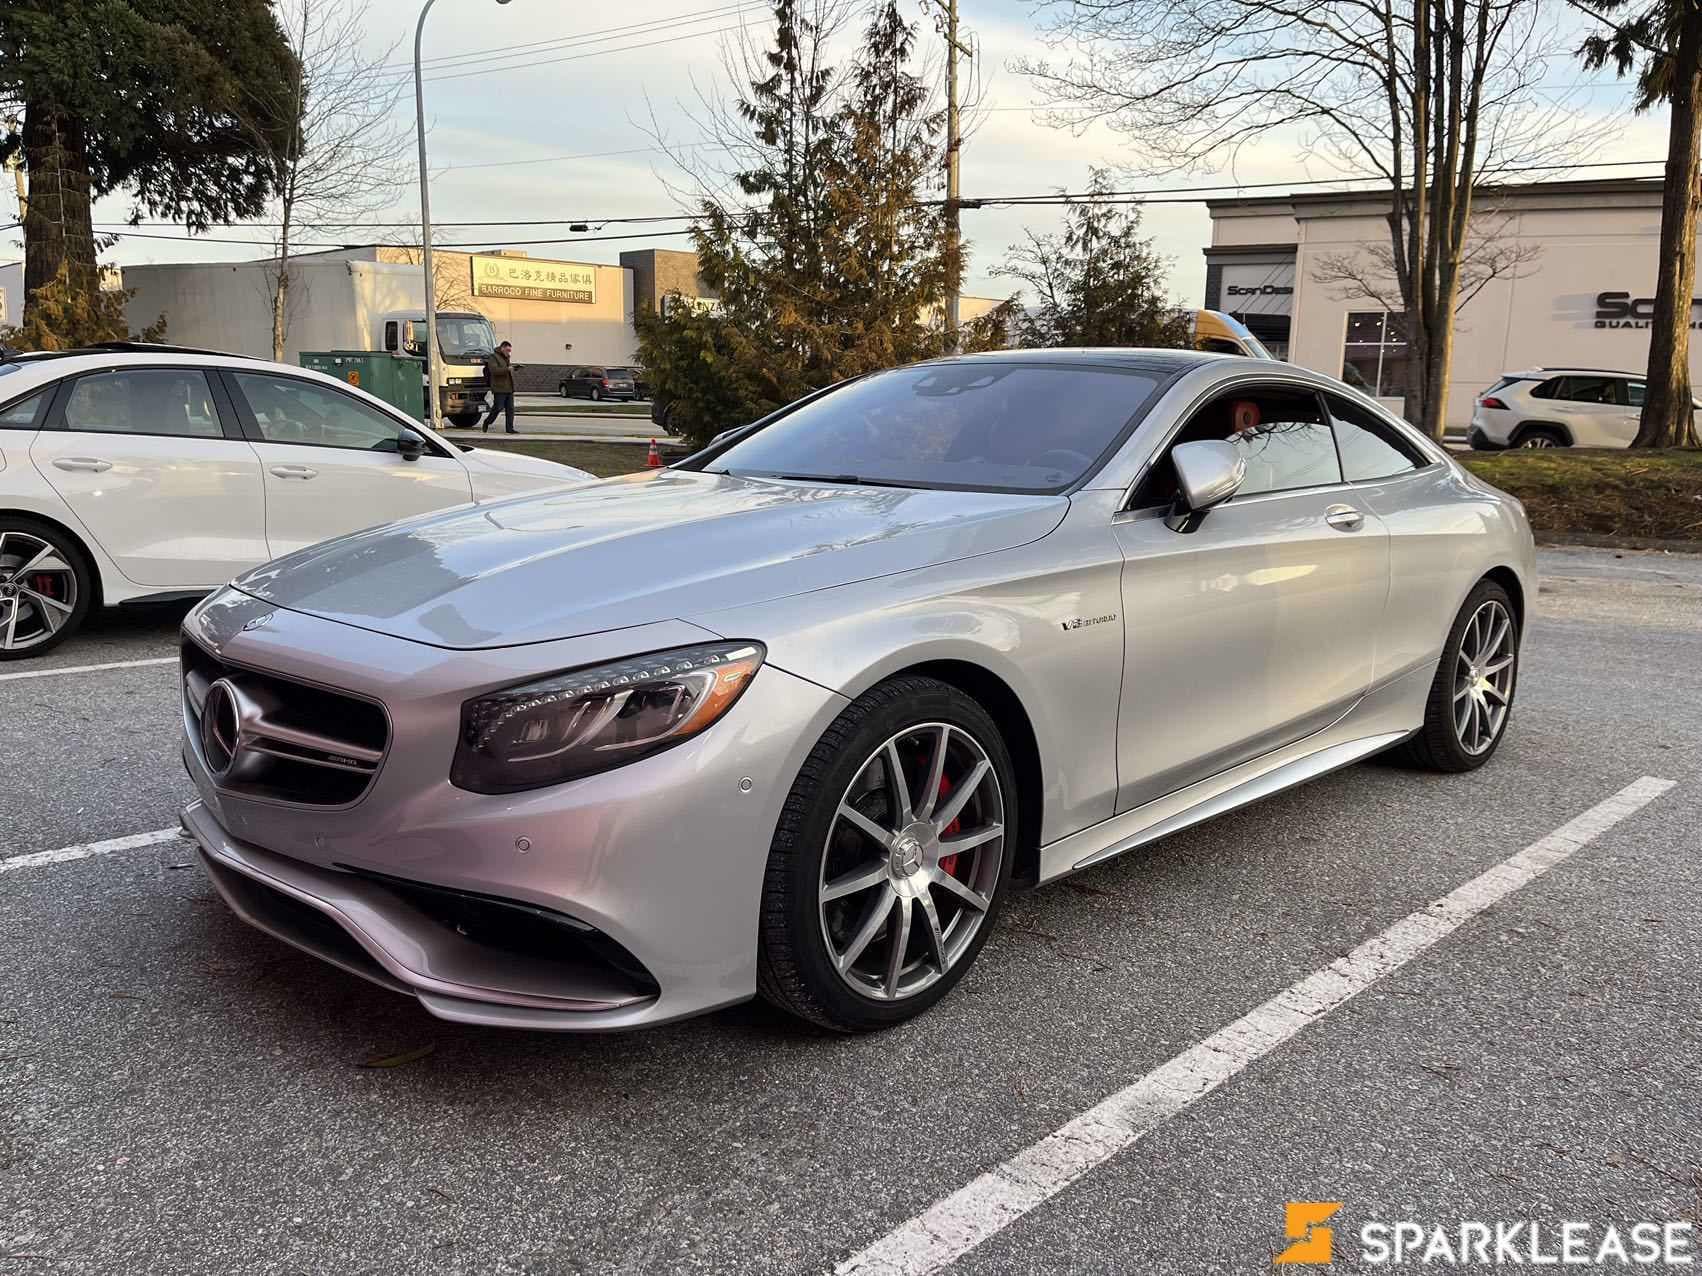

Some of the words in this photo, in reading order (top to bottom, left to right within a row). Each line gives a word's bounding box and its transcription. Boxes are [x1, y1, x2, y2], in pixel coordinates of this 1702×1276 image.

[481, 285, 521, 296] BARROCO
[525, 288, 543, 297] FINE
[547, 289, 590, 300] FURNITURE
[1594, 320, 1650, 329] QUALI
